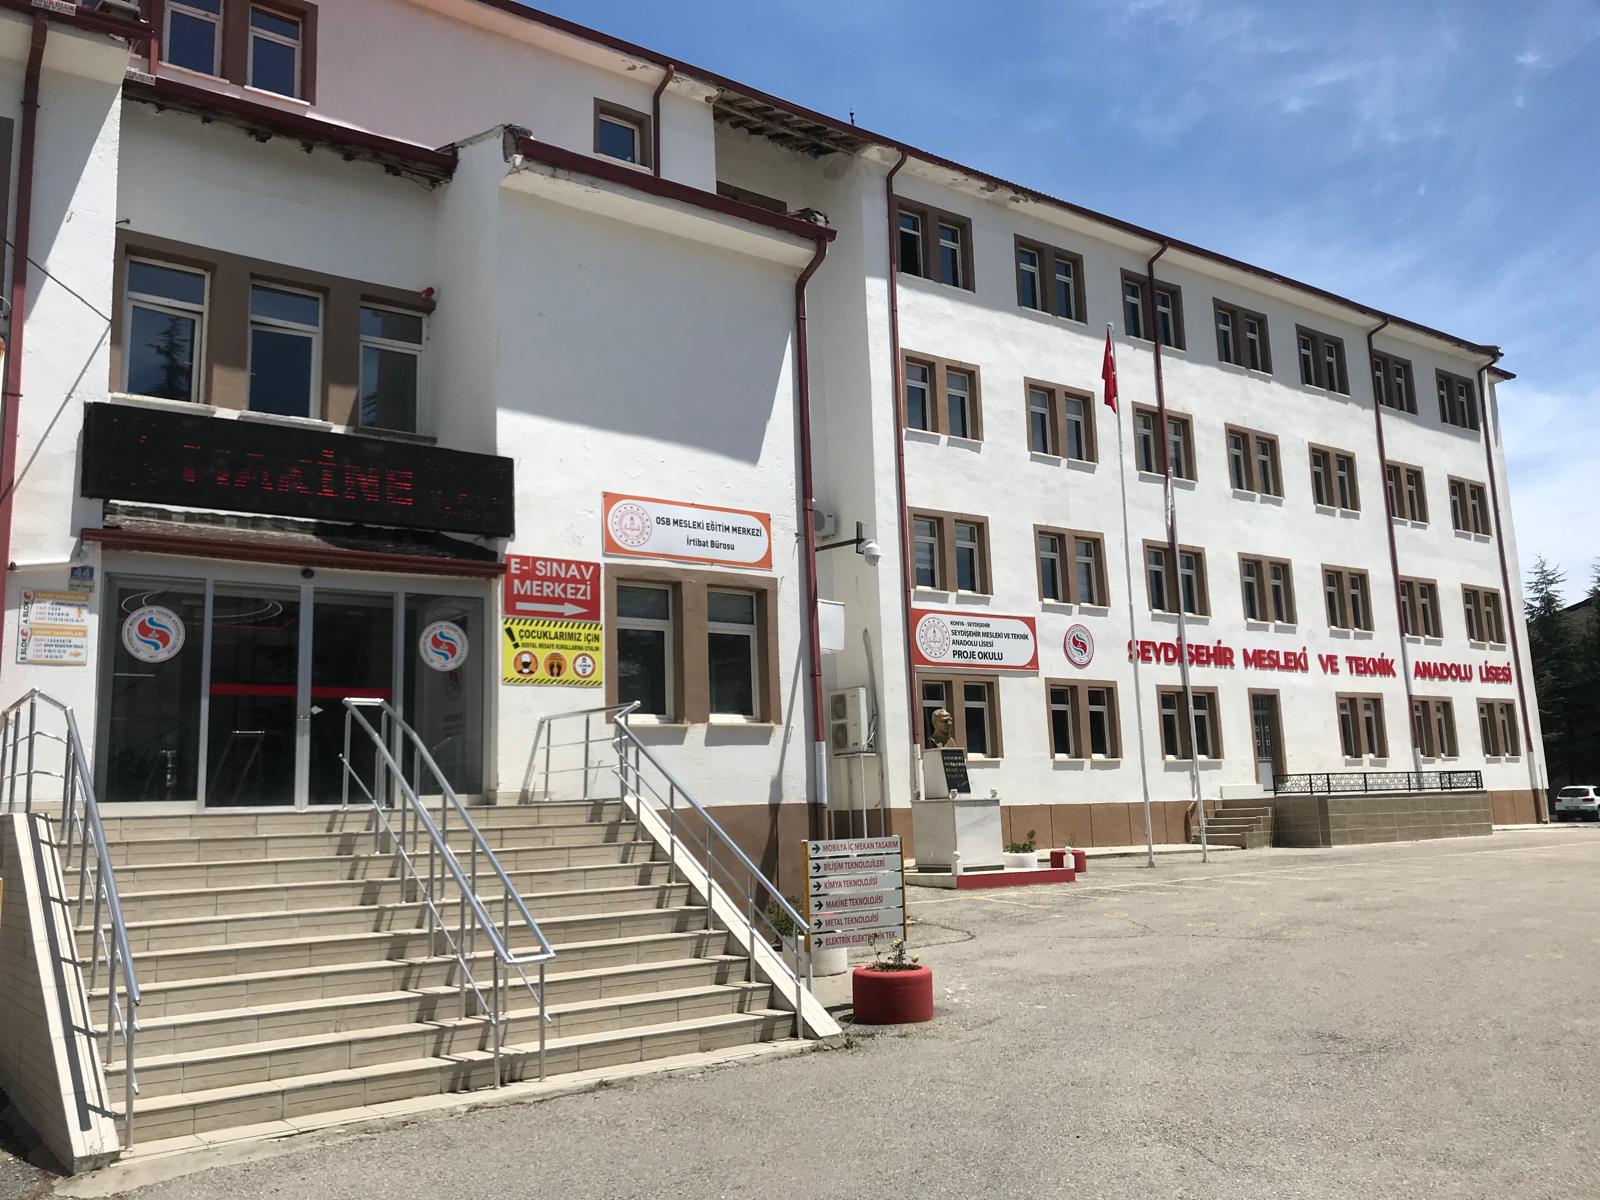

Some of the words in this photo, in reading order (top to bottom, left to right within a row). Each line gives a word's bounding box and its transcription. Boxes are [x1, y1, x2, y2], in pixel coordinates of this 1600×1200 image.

[656, 516, 671, 526] OSB
[672, 518, 705, 530] MESLEKİ
[706, 521, 730, 533] EĞİTİM
[732, 526, 762, 537] MERKEZİ
[686, 535, 709, 547] İrtibat
[711, 540, 735, 551] Bürosu
[511, 558, 529, 574] E-
[535, 560, 594, 580] SINAV
[513, 578, 591, 600] MERKEZİ
[519, 629, 582, 642] ÇOCUKLARIMIZ
[951, 629, 981, 638] SEYDİŞEHİR
[982, 630, 1003, 639] MESLEKİ
[979, 640, 994, 648] LİSESİ
[952, 650, 977, 660] PROJE
[978, 651, 1003, 660] OKULU
[1242, 646, 1309, 672] MESLEKİ
[1317, 654, 1340, 674] VE
[1345, 652, 1396, 677] TEKNİK
[1414, 660, 1473, 681] ANADOLU
[1479, 660, 1512, 683] LİSESİ
[823, 842, 847, 852] MOBİLYA
[854, 842, 874, 851] MEKAN
[875, 840, 898, 849] TASARIM
[824, 860, 843, 872] BİLİŞİM
[845, 858, 885, 870] TEKNOLOJİLERİ
[824, 879, 842, 889] KİMYA
[843, 876, 877, 887] TEKNOLOJİSİ
[825, 897, 848, 909] MAKİNE
[849, 894, 883, 907] TEKNOLOJİSİ
[825, 918, 844, 927] METAL
[844, 913, 879, 925] TEKNOLOJİSİ
[826, 934, 851, 946] ELEKTRİK
